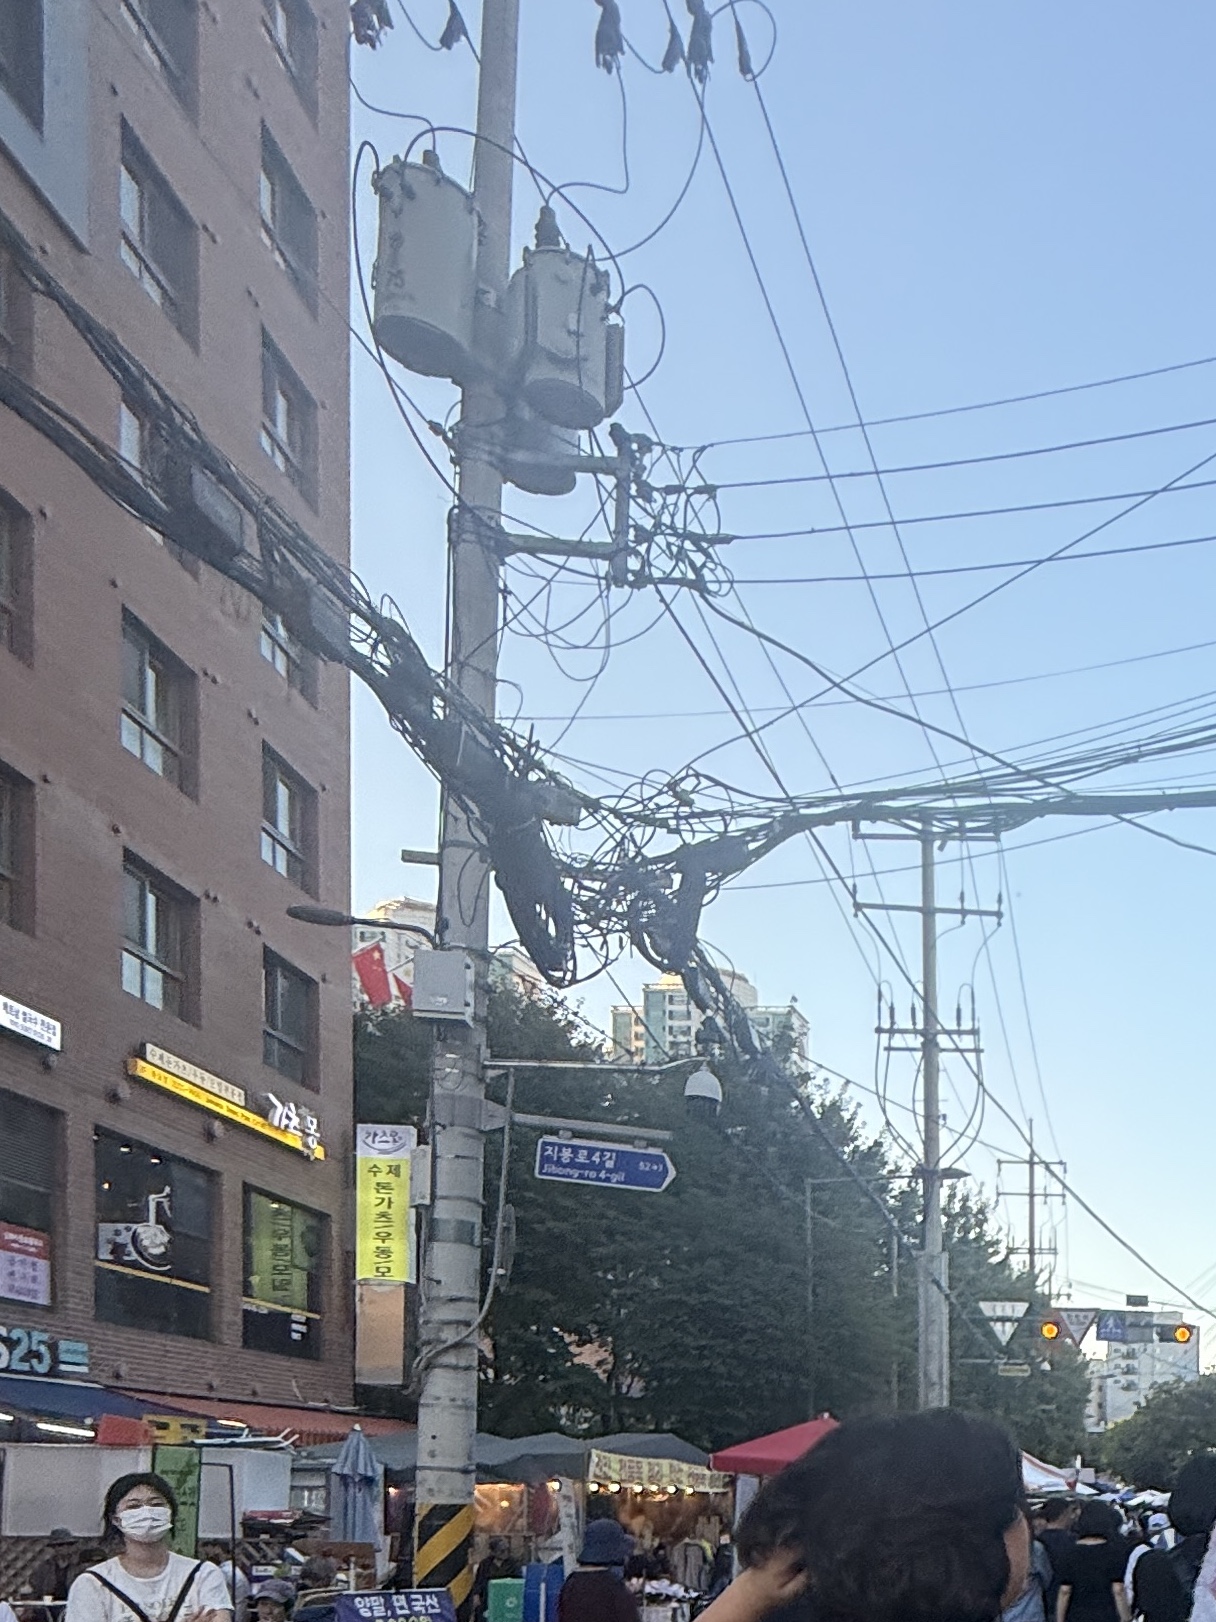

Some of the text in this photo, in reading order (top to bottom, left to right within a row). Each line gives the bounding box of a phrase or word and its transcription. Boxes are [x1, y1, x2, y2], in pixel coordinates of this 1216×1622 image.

[543, 1145, 617, 1169] 지봉로4길
[367, 1164, 401, 1178] 수제
[541, 1163, 626, 1183] Jibong-ro 4-gil
